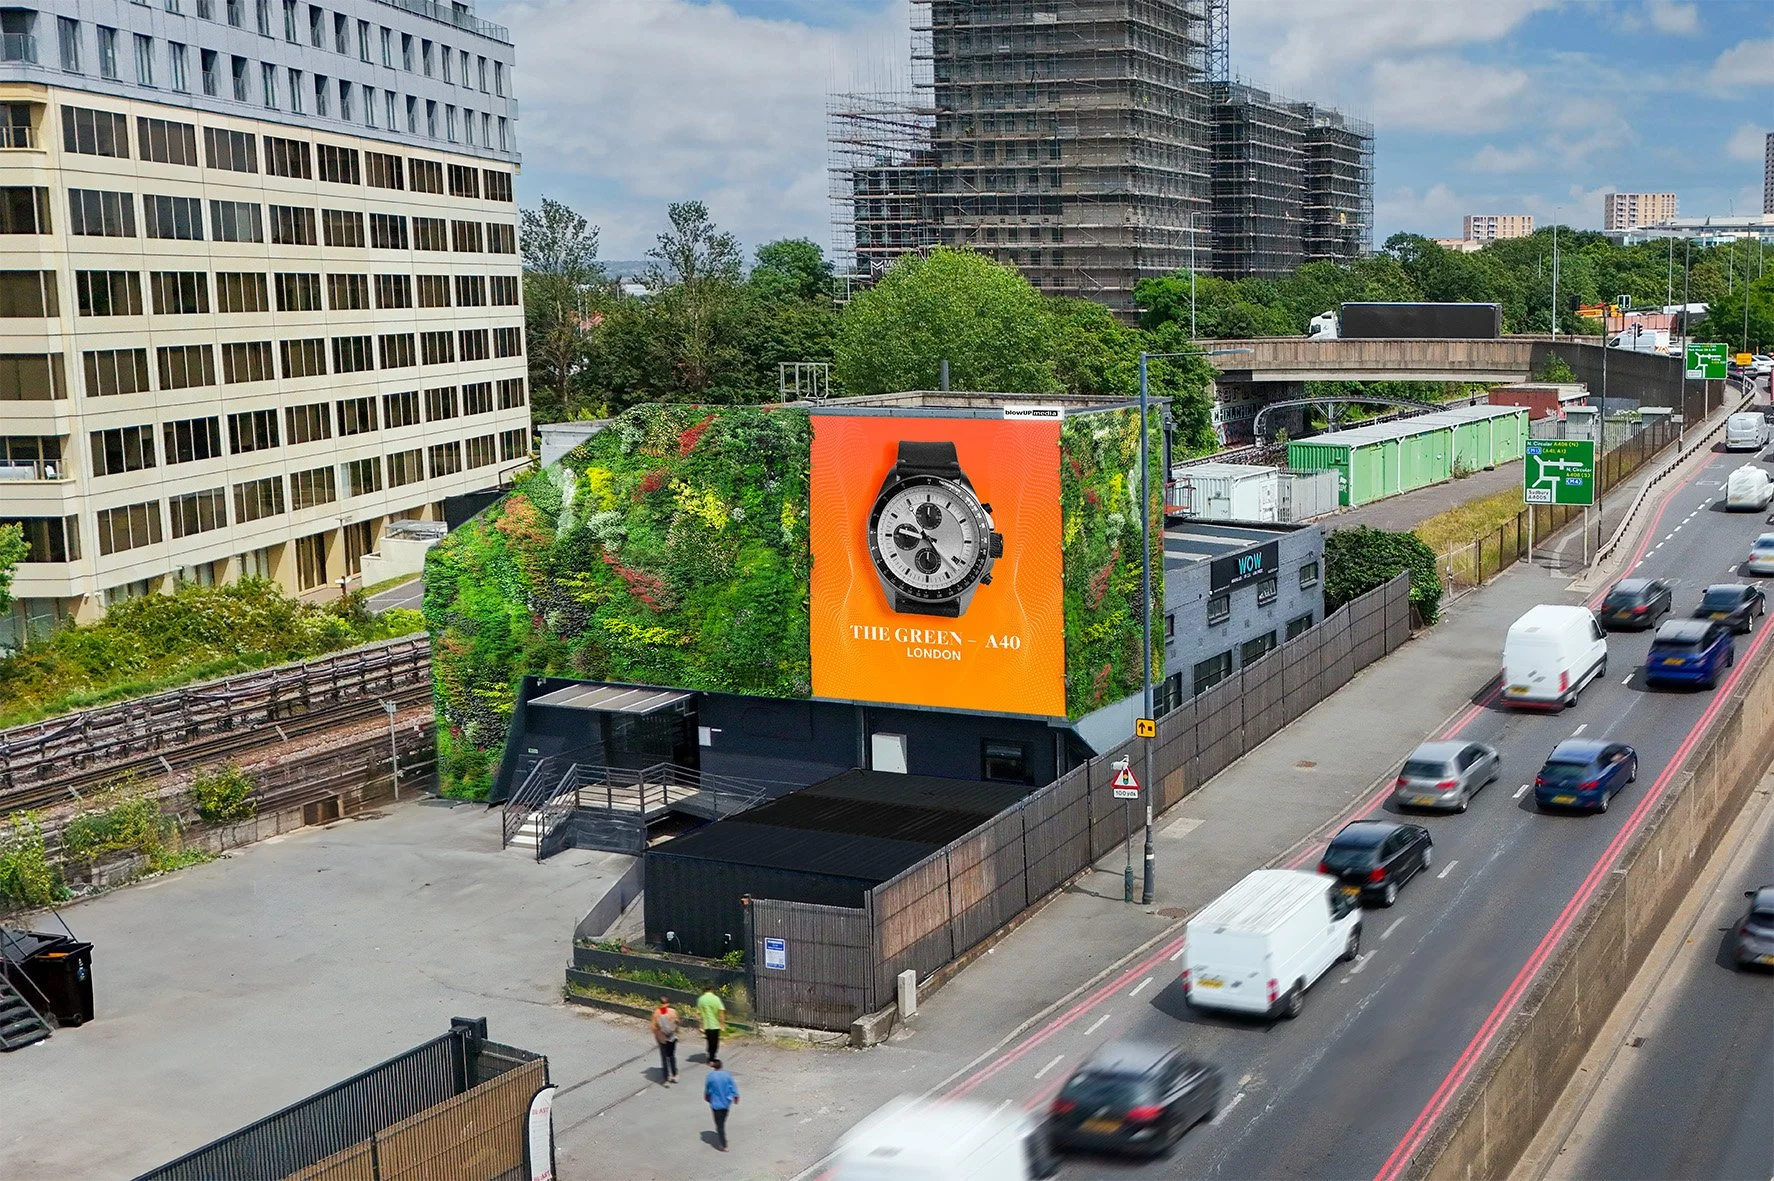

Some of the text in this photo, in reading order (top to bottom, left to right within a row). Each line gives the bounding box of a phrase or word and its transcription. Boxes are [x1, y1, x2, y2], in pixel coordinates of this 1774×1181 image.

[1238, 552, 1262, 575] WOW
[850, 625, 890, 641] THE
[894, 627, 962, 646] GREEN
[985, 634, 1021, 650] A40
[907, 647, 961, 661] LONDON
